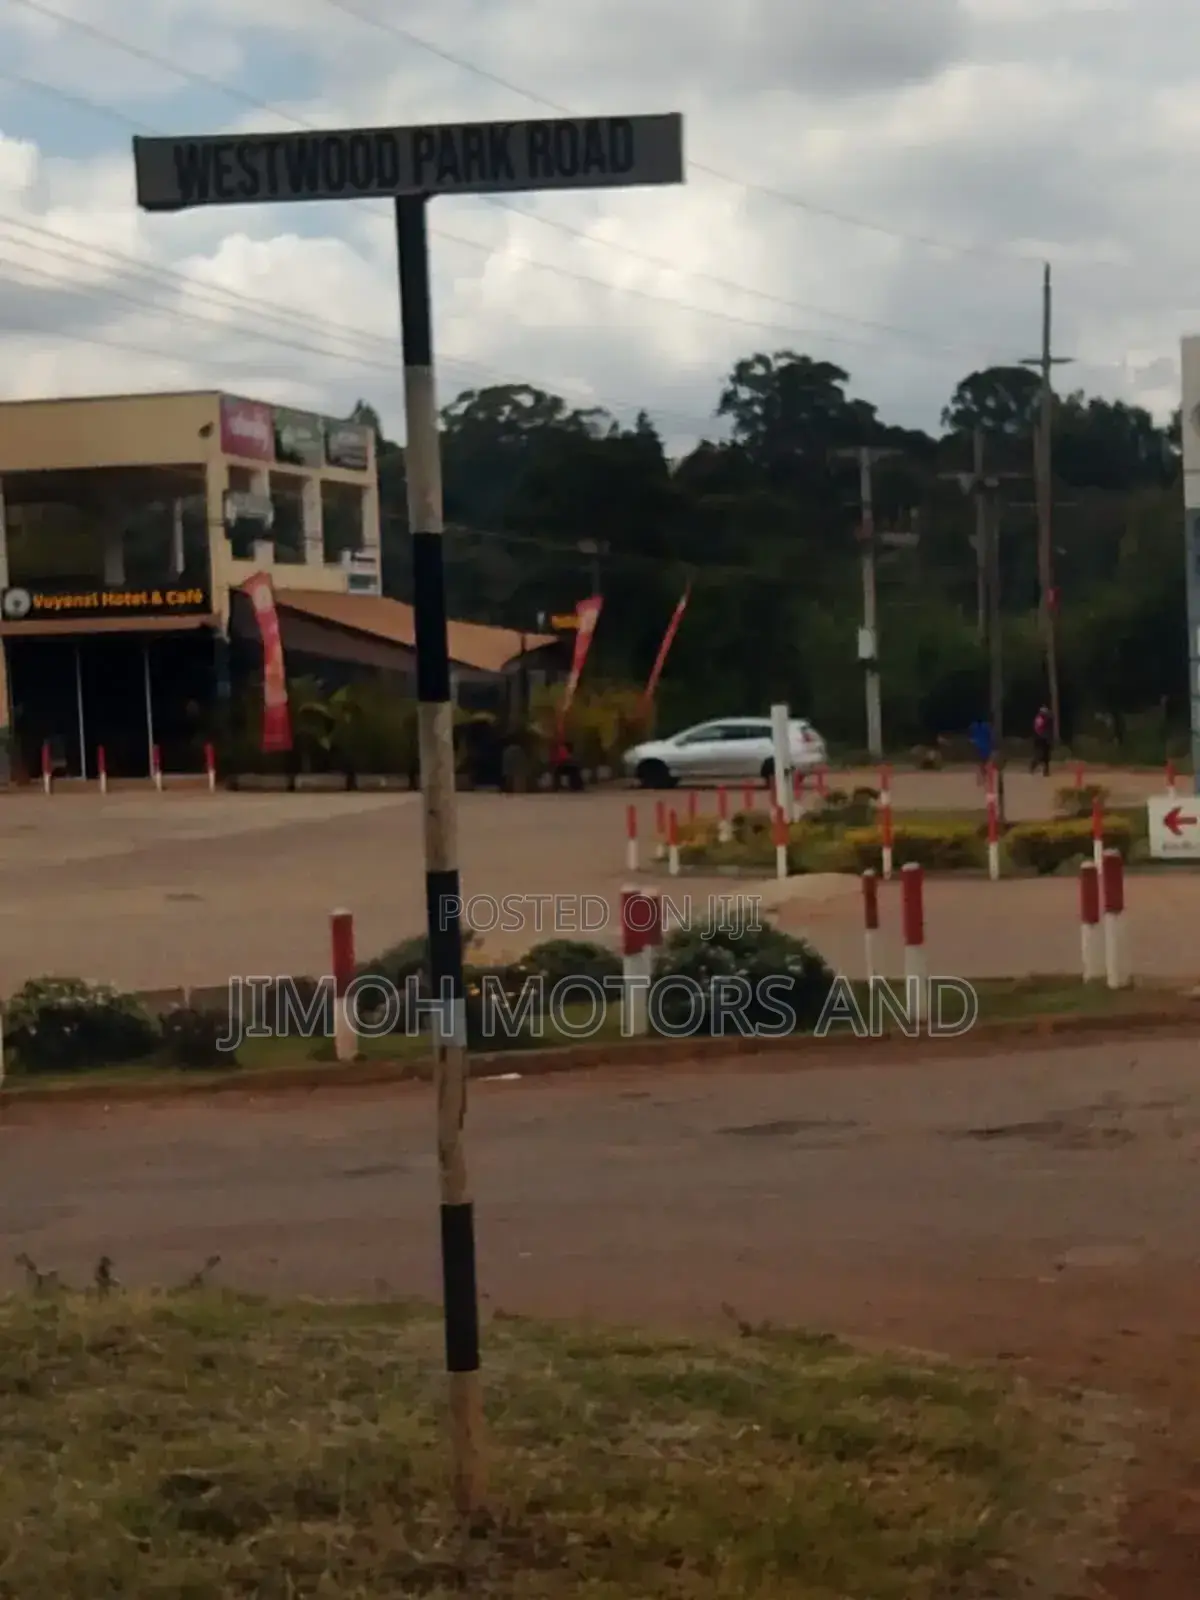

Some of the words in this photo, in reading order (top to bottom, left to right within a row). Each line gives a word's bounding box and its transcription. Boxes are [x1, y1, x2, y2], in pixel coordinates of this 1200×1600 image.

[175, 134, 398, 203] WESTWOOD
[412, 123, 513, 188] PARK
[527, 116, 636, 176] ROAD
[103, 590, 147, 607] Hotel
[151, 590, 164, 605] &
